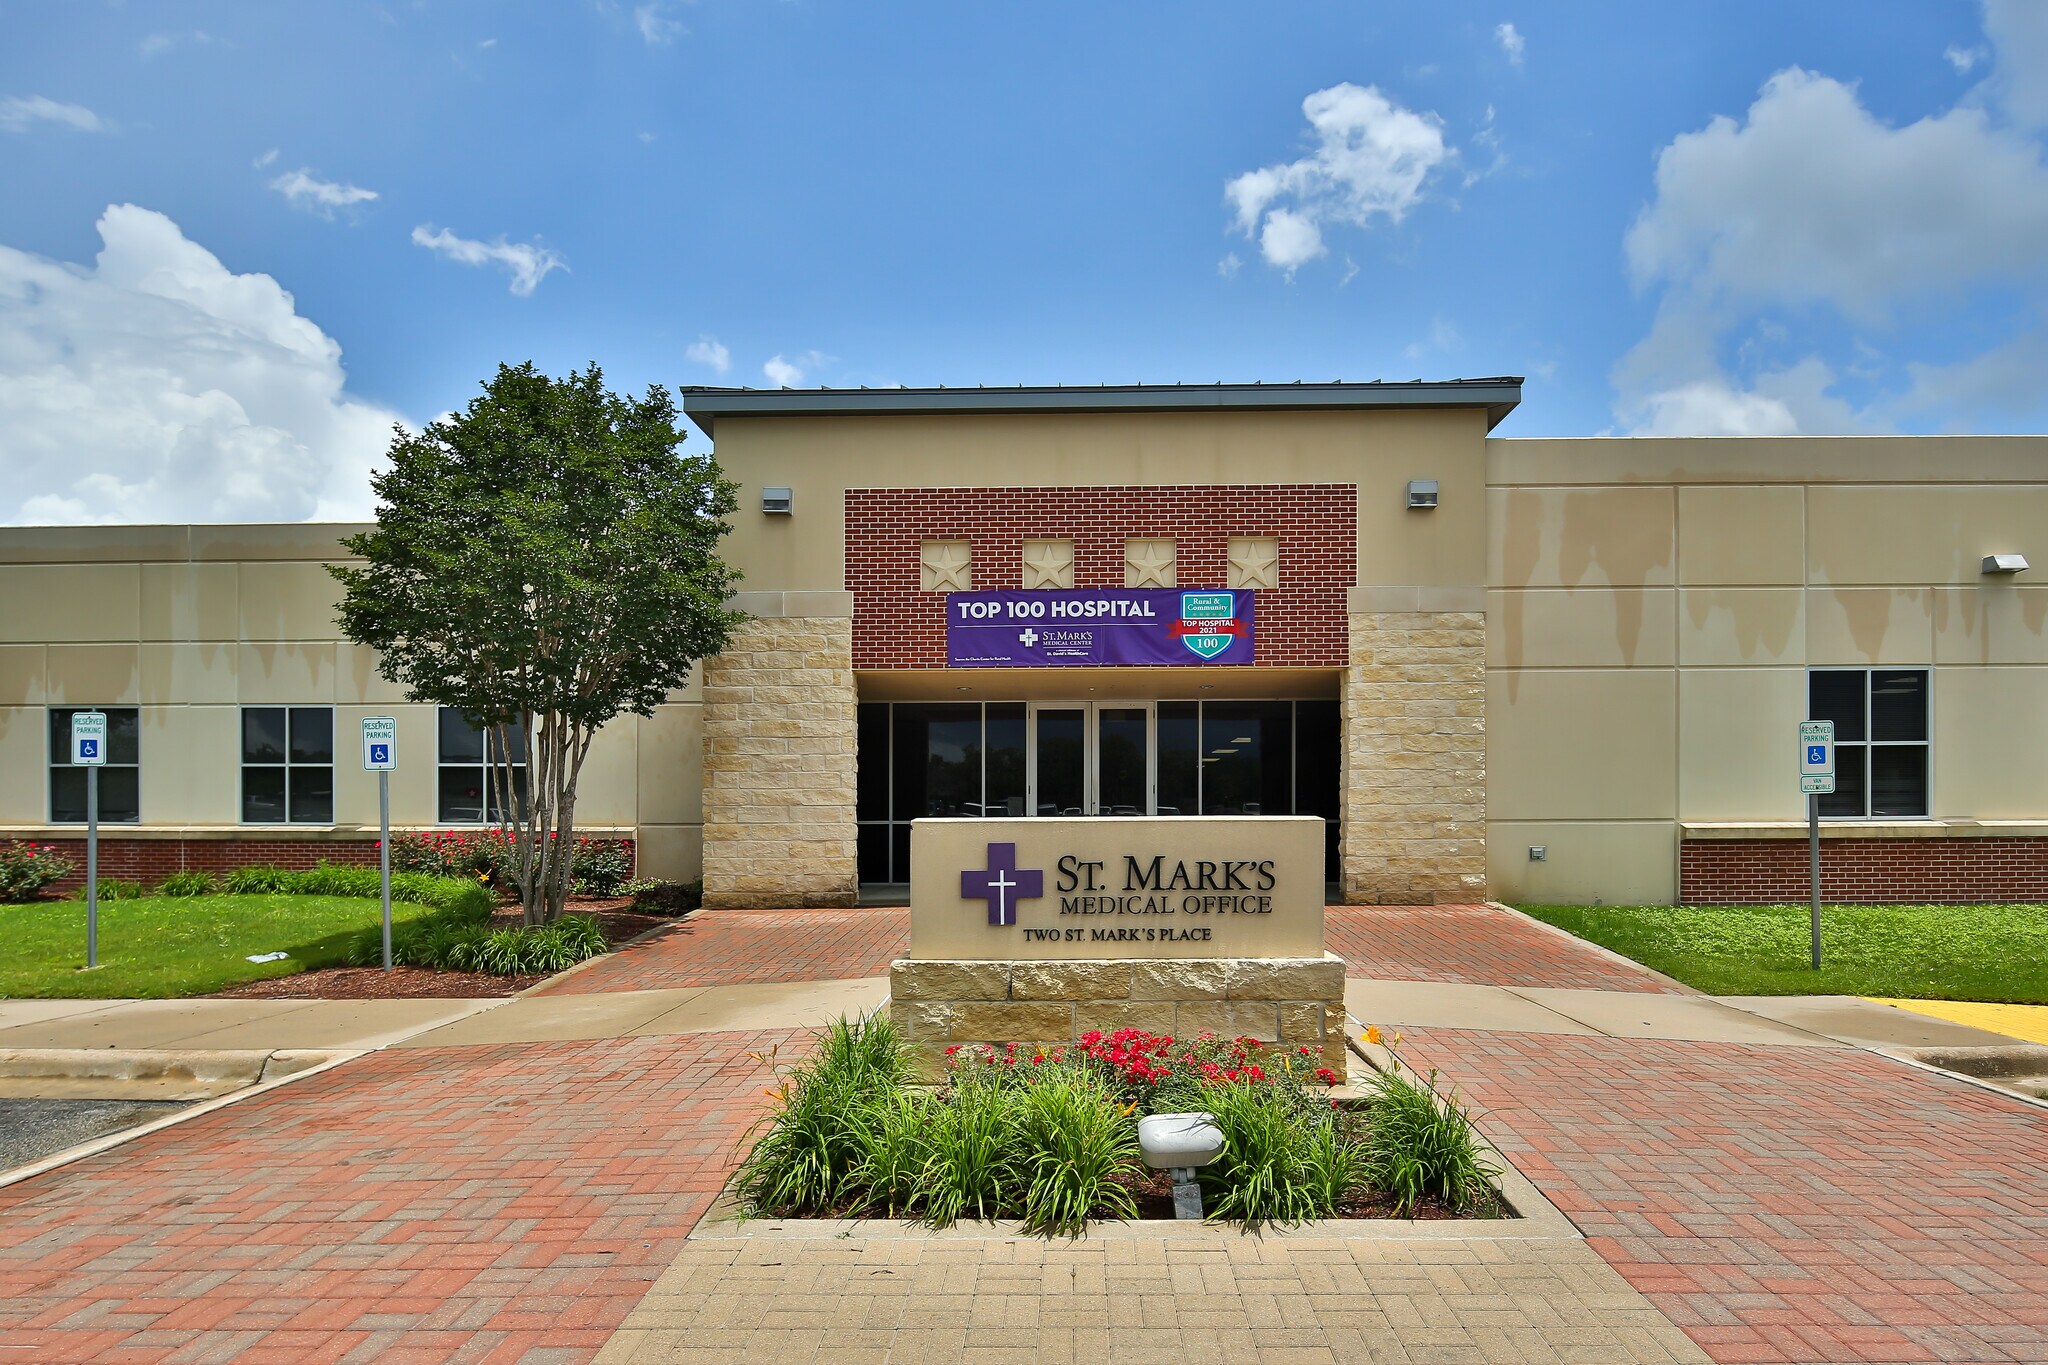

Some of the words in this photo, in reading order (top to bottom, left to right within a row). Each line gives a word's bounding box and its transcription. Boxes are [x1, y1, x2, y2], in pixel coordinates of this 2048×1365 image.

[958, 602, 1001, 618] TOP
[1007, 601, 1046, 618] 100
[1051, 600, 1156, 617] HOSPITAL
[1188, 604, 1228, 612] Community
[1198, 638, 1218, 648] 100
[1802, 726, 1832, 734] RESERVED
[1056, 855, 1105, 893] ST.
[1122, 855, 1276, 892] MARK'S
[1059, 896, 1175, 915] MEDICAL
[1183, 895, 1273, 914] OFFICE
[1023, 928, 1060, 942] TWO
[1064, 928, 1086, 941] ST.
[1090, 928, 1157, 941] MARK'S
[1160, 928, 1213, 941] PLACE
